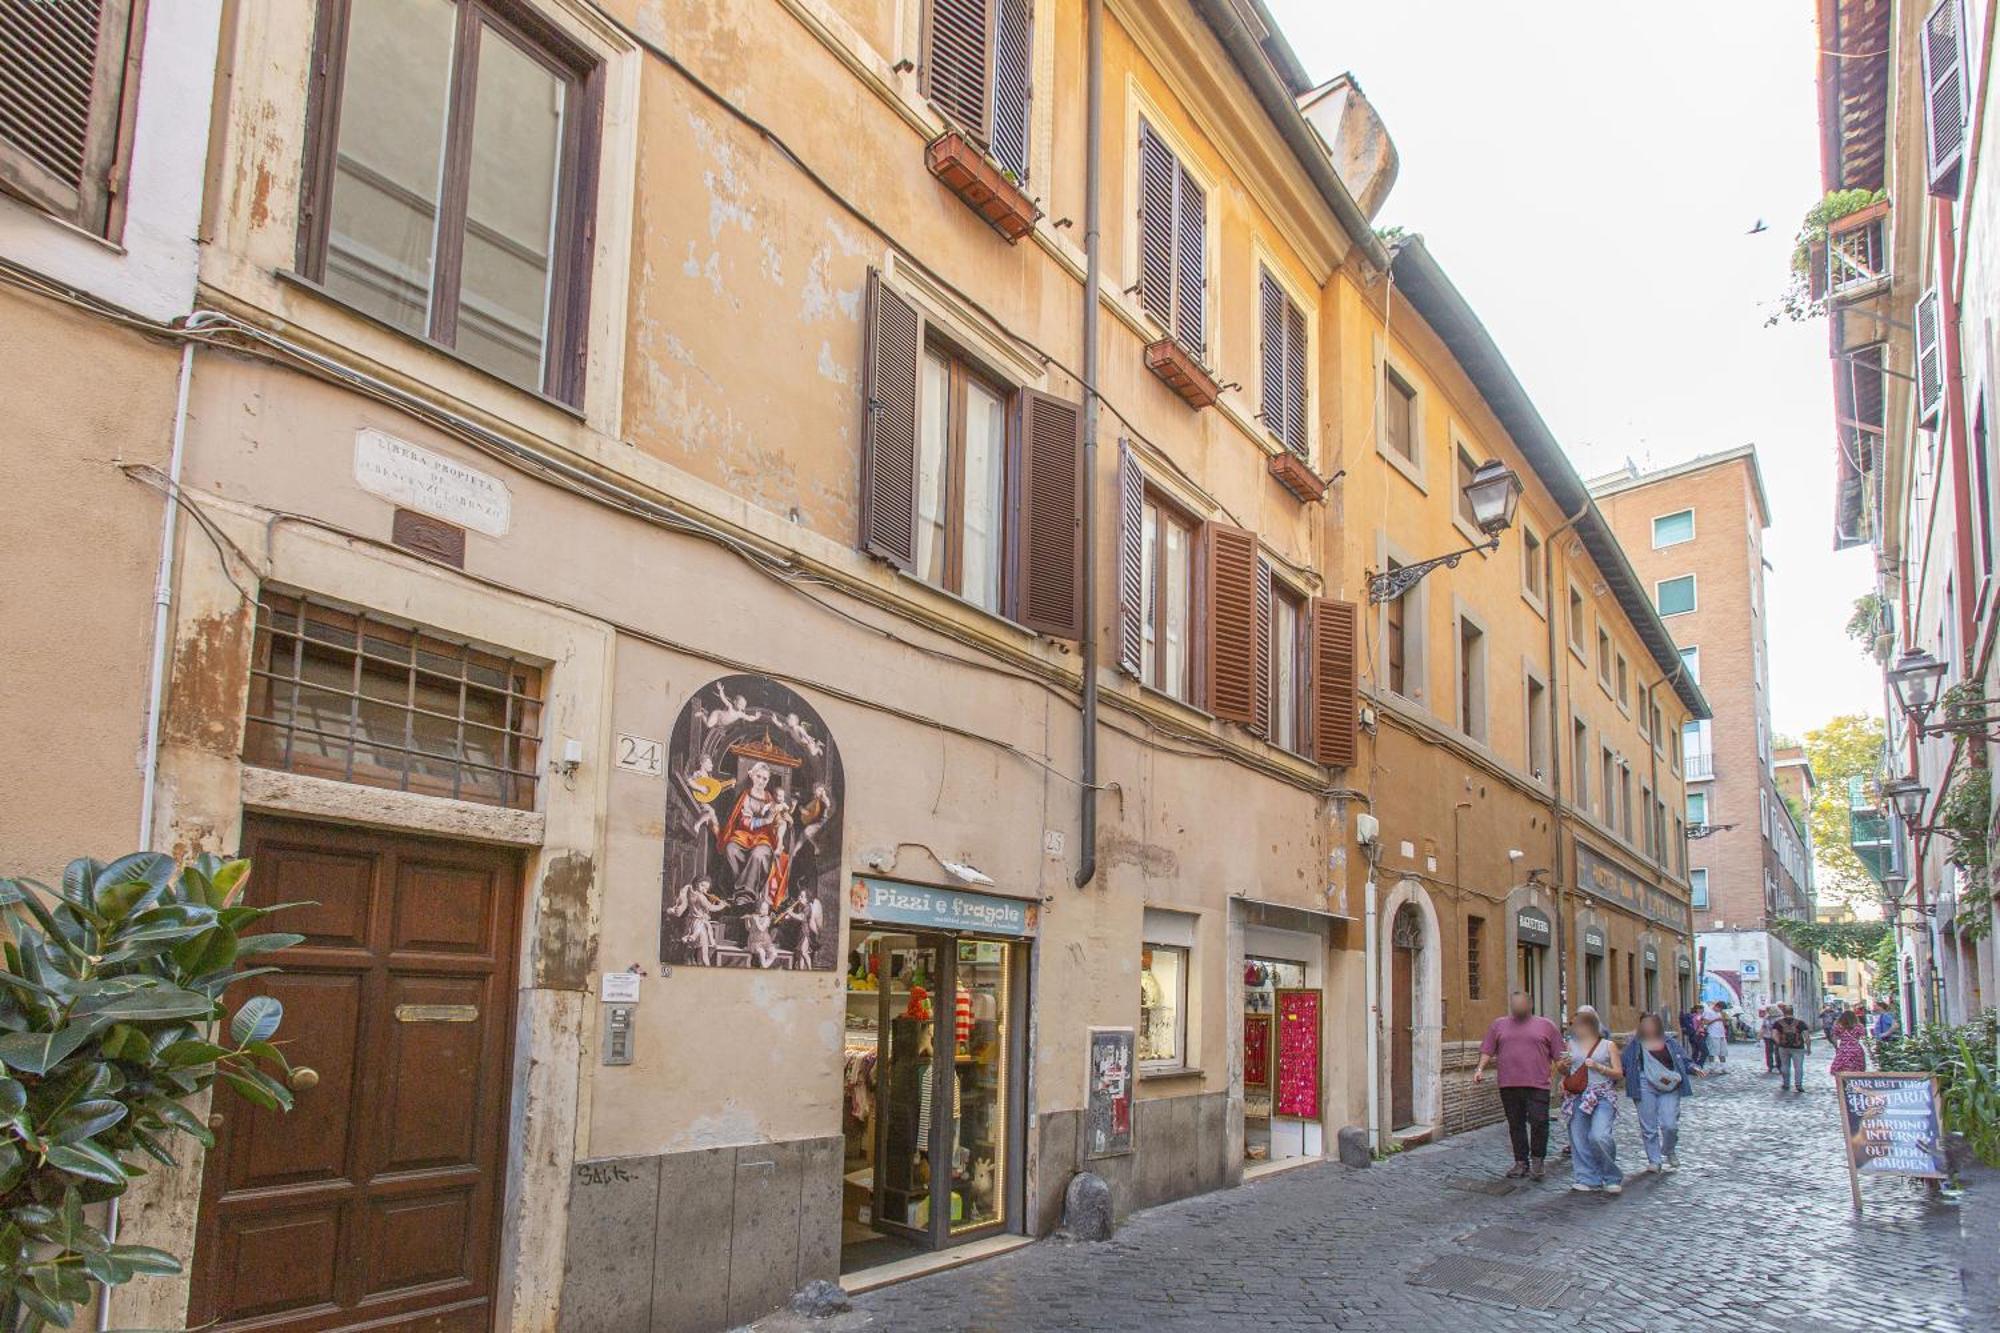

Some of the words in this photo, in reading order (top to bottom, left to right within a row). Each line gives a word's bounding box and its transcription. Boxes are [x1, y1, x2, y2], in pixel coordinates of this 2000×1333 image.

[378, 438, 427, 466] LIBERA
[434, 461, 494, 492] PROPIETA
[620, 737, 660, 770] 24
[874, 888, 931, 912] Pizzi
[935, 900, 948, 914] e
[952, 897, 1019, 923] fragole
[1848, 1090, 1930, 1113] HOSTARIA
[1862, 1119, 1929, 1131] GIARDINO
[1873, 1158, 1929, 1171] GARDEN
